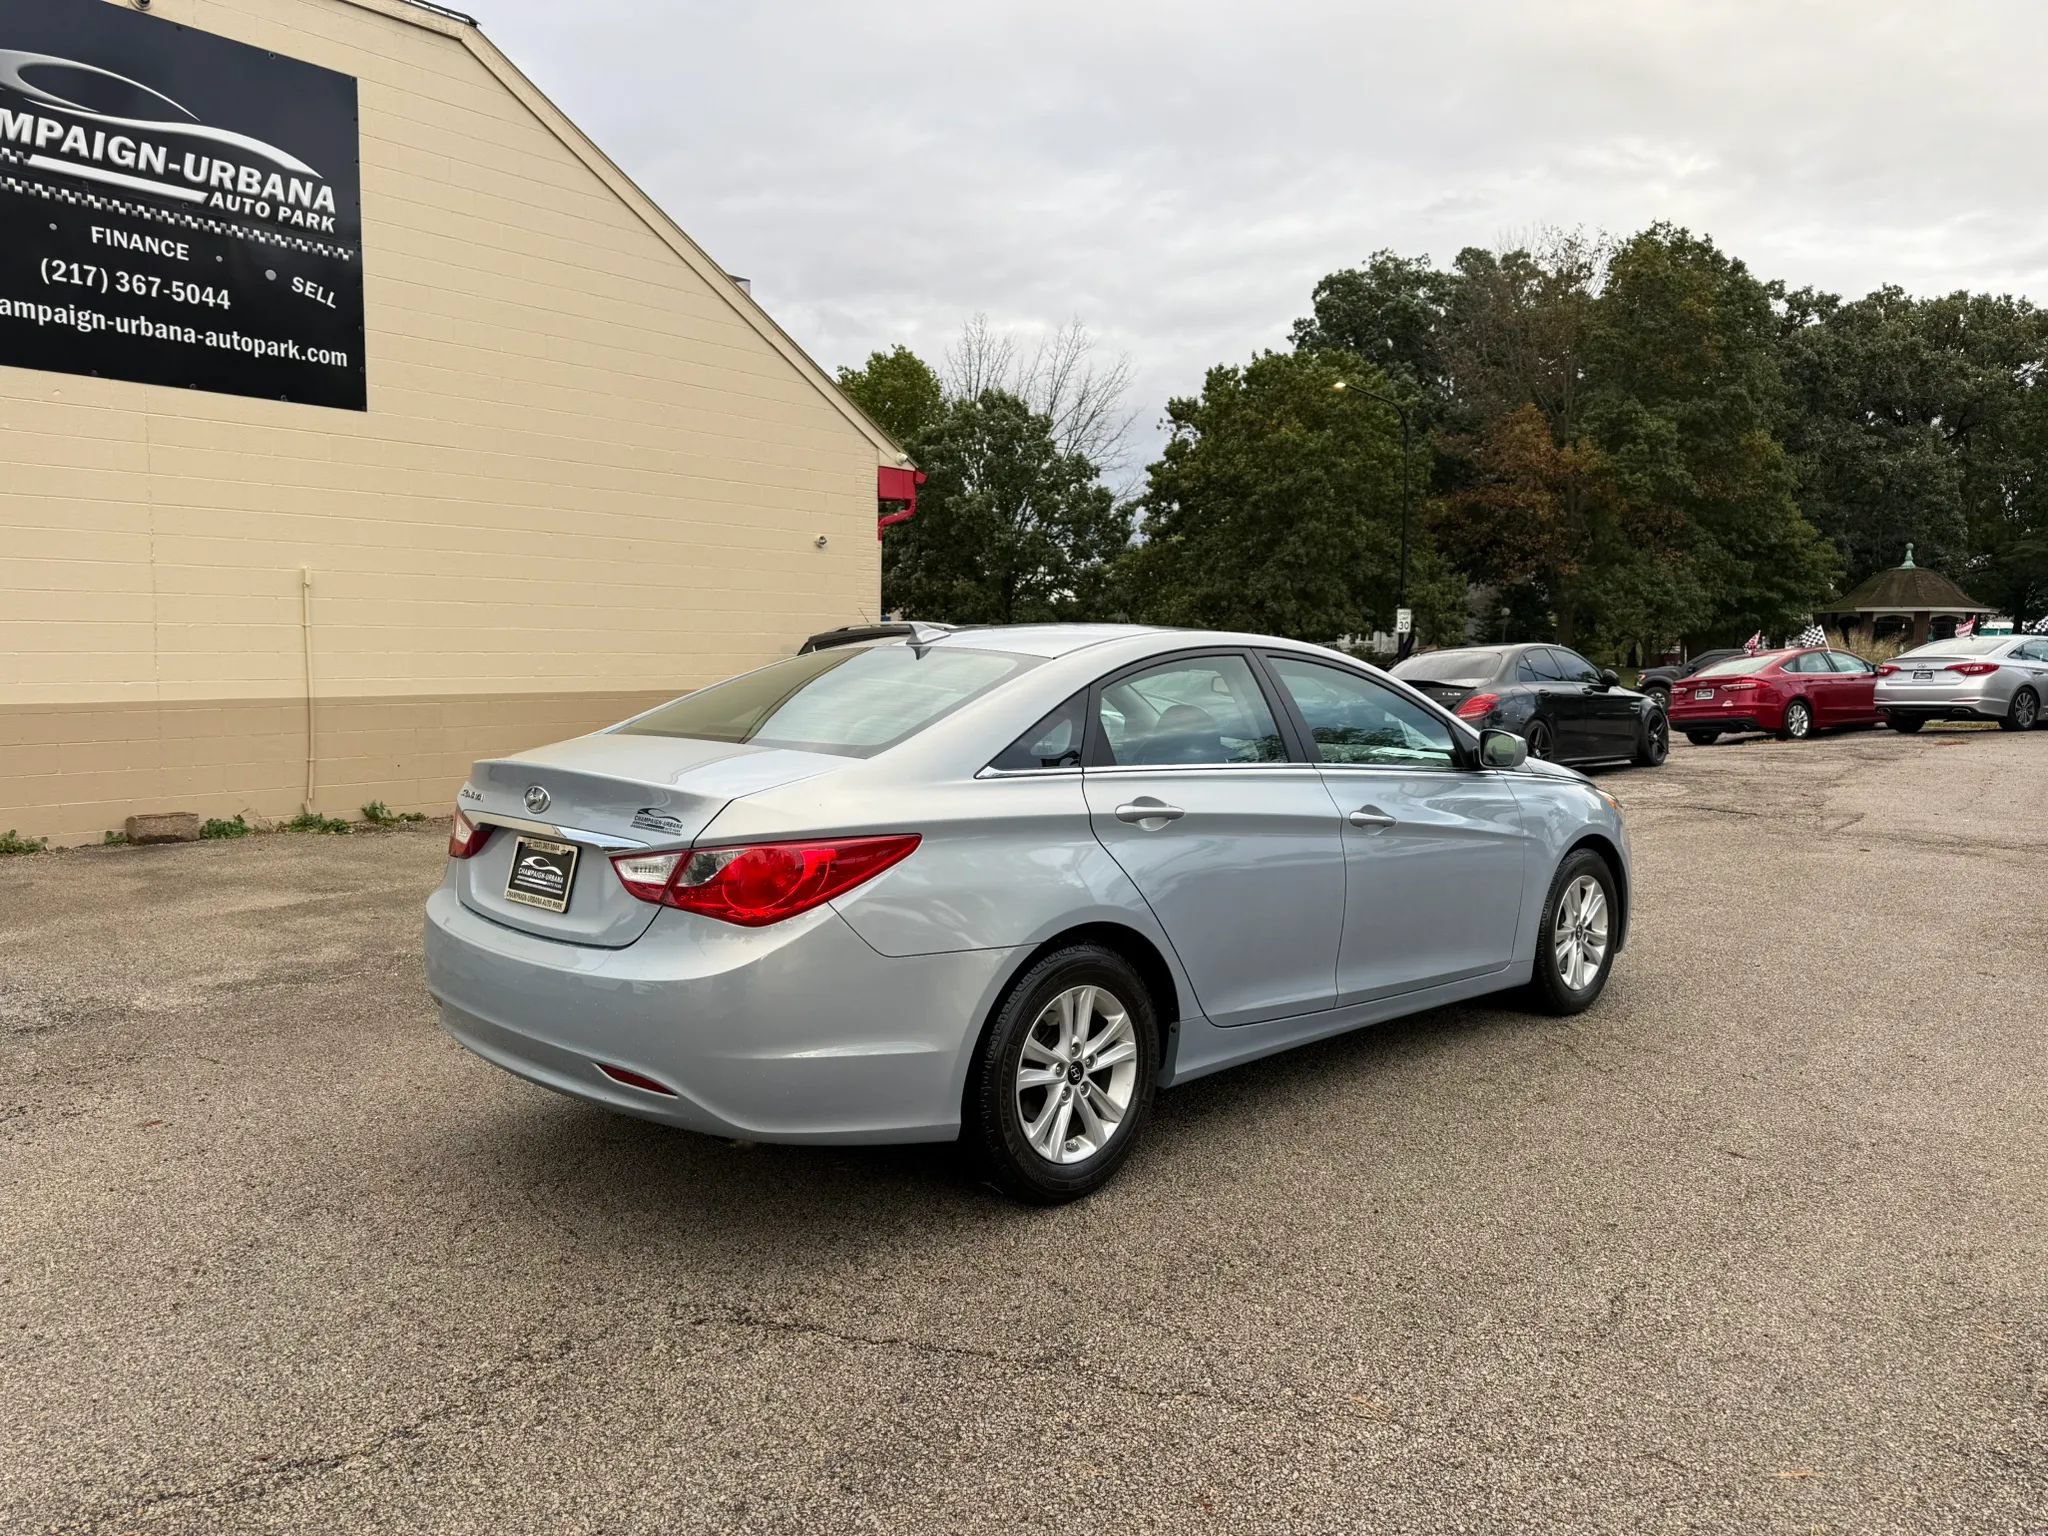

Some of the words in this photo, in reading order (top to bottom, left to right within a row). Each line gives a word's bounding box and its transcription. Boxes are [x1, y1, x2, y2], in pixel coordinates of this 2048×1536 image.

[209, 191, 271, 218] AUTO
[277, 206, 336, 234] PARK
[91, 226, 190, 261] FINANCE
[41, 257, 108, 294] (217)
[115, 271, 231, 310] 367-5044
[291, 276, 337, 309] SELL
[0, 298, 348, 367] ampaign-urbana-autopark.com
[1398, 621, 1409, 630] 30
